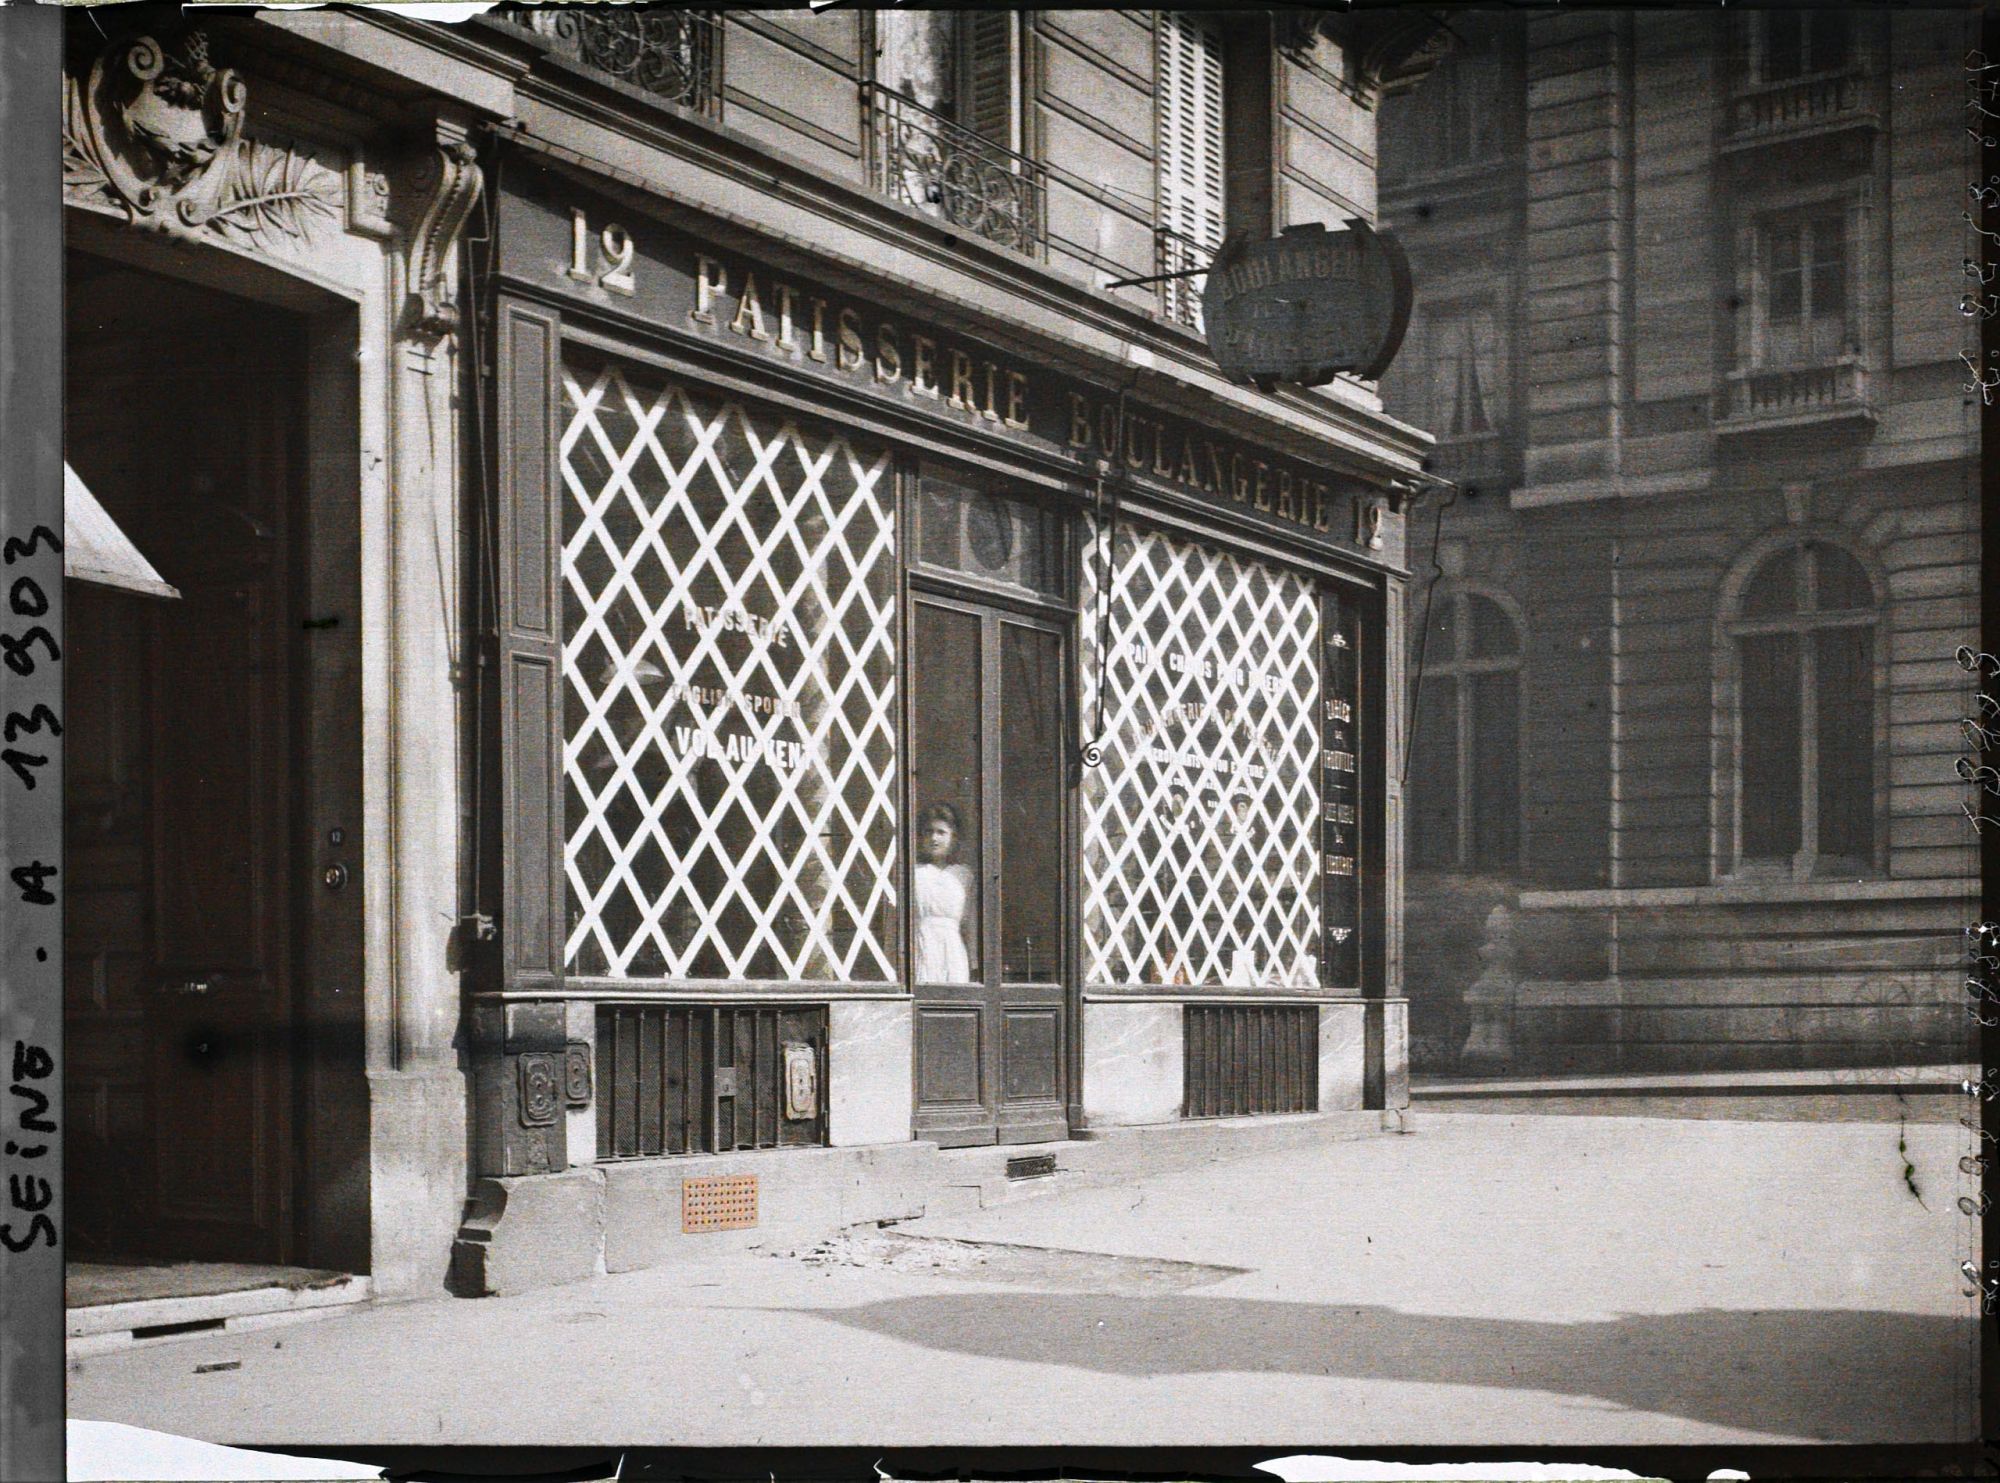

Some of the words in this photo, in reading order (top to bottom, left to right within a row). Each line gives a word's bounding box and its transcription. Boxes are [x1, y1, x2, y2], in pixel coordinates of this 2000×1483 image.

[568, 206, 635, 297] 12
[691, 251, 1030, 432] PATISSERIE
[1067, 390, 1330, 533] BOULANGERIE
[726, 734, 754, 763] AU
